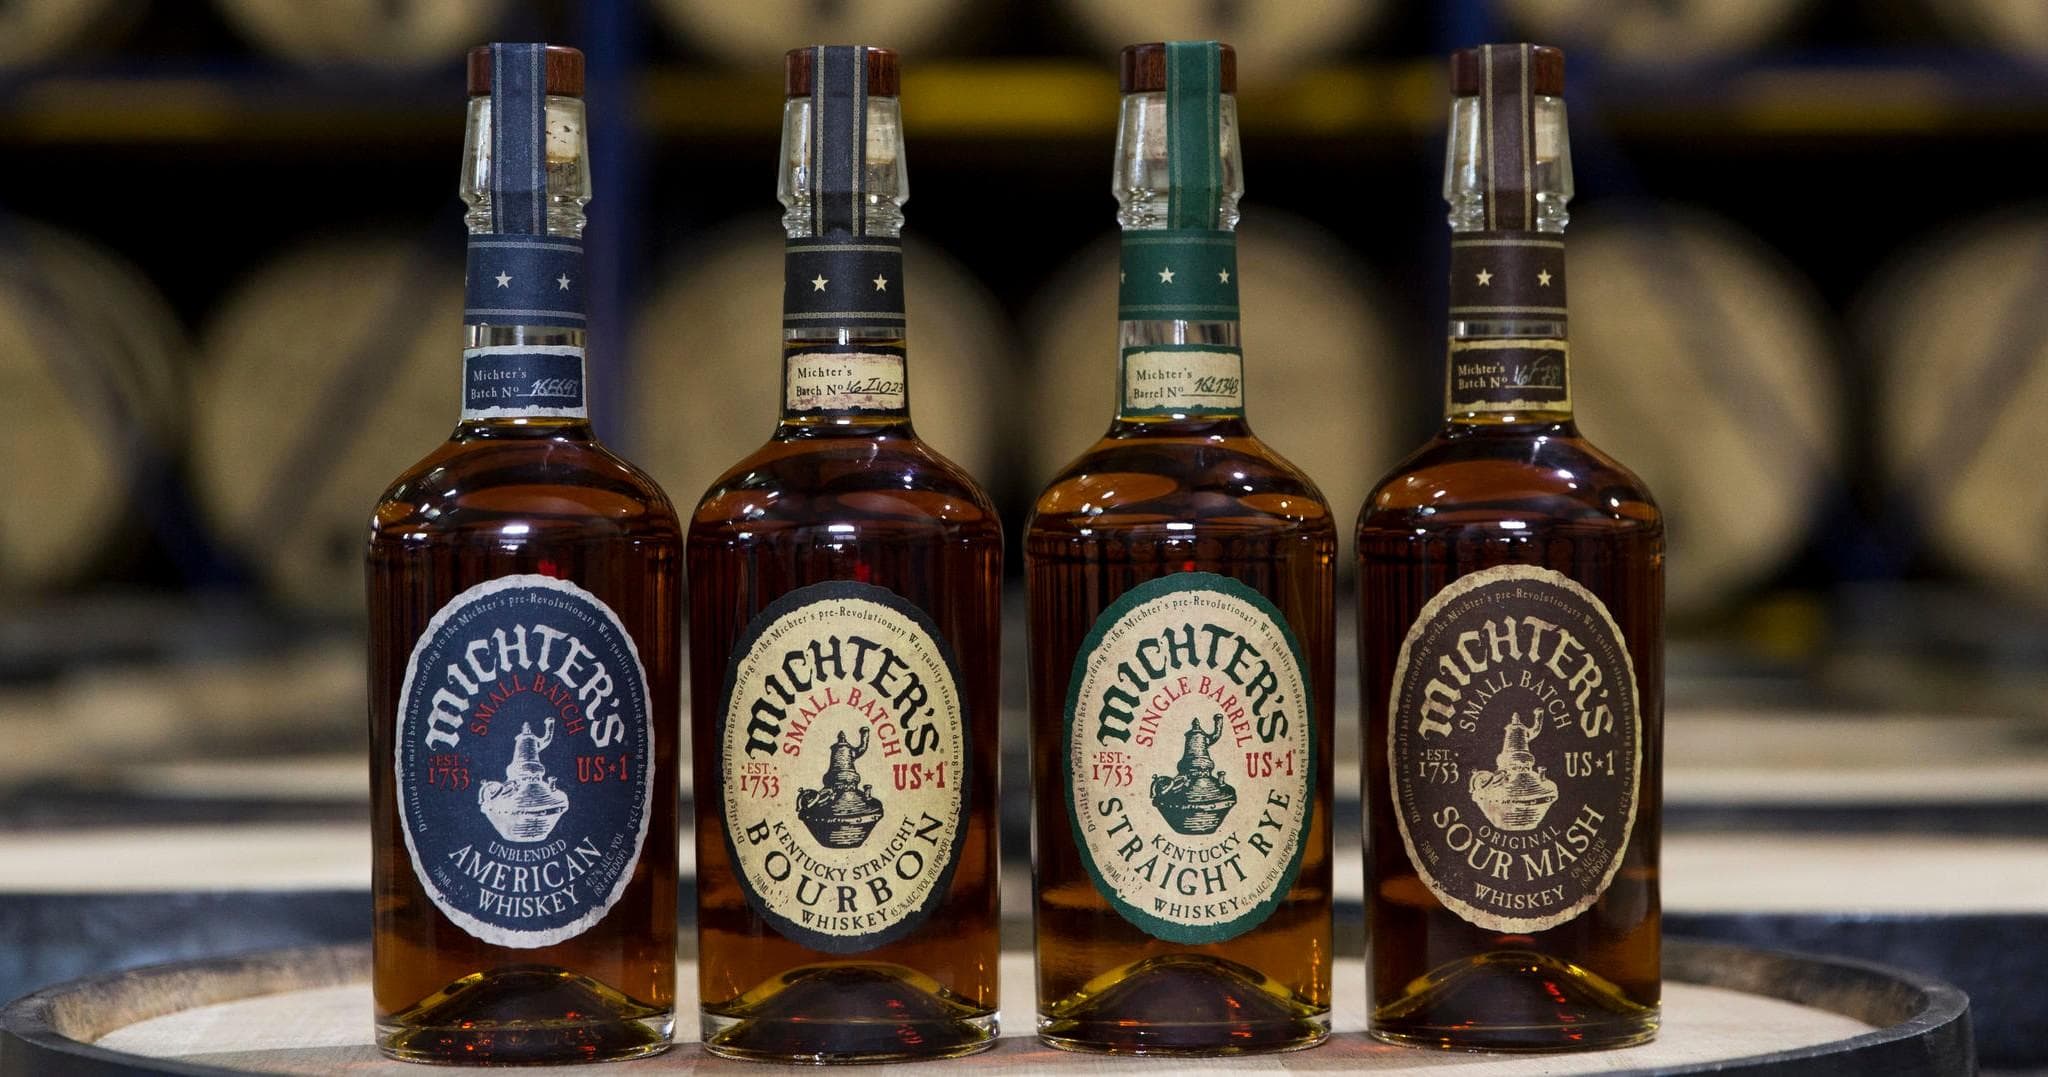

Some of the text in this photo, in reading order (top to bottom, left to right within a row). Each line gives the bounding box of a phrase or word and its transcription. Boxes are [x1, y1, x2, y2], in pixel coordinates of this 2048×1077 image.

[474, 367, 527, 381] Michter's
[798, 365, 852, 378] Michter's
[1136, 368, 1192, 381] Michter's
[1458, 362, 1505, 376] Michter's
[1458, 377, 1486, 390] Batch
[471, 387, 497, 400] Batch
[796, 385, 821, 397] Batch
[1134, 387, 1163, 399] Barrel
[1124, 601, 1169, 630] Michter's
[1173, 596, 1257, 627] pre-Revolutionary
[1448, 593, 1491, 622] Michter's
[1496, 588, 1581, 617] pre-Revolutionary
[771, 612, 814, 640] Michter's
[819, 606, 905, 639] pre-Revolutionary
[1111, 629, 1124, 642] the
[1260, 622, 1273, 640] War
[416, 651, 440, 695] according
[436, 640, 446, 649] to
[445, 624, 458, 638] the
[457, 597, 505, 627] Michter's
[509, 592, 596, 625] pre-Revolutionary
[599, 622, 611, 643] War
[758, 639, 771, 653] the
[909, 633, 922, 652] War
[1104, 644, 1111, 653] to
[1272, 641, 1291, 671] quality
[752, 653, 760, 663] to
[921, 652, 942, 683] quality
[425, 624, 625, 751] MICHTER'S
[733, 665, 755, 710] according
[1084, 655, 1106, 698] according
[1097, 623, 1289, 747] MICHTER'S
[1419, 616, 1614, 741] MICHTER'S
[470, 672, 585, 737] SMALL BATCH
[745, 635, 940, 759] MICHTER'S
[941, 685, 956, 731] standards
[1289, 674, 1304, 718] standards
[1460, 670, 1572, 733] SMALL BATCH
[783, 687, 902, 758] SMALL BATCH
[1076, 702, 1086, 738] batches
[1136, 676, 1253, 748] SINGLE BARREL
[726, 713, 736, 750] batches
[1299, 723, 1308, 754] dating
[428, 767, 471, 791] 1753
[725, 754, 733, 783] small
[1093, 765, 1133, 787] 1753
[1420, 762, 1459, 784] 1753
[727, 784, 733, 793] in
[741, 776, 779, 798] 1753
[951, 796, 958, 806] to
[728, 799, 744, 844] Distilled
[945, 812, 956, 835] 1753
[1078, 788, 1096, 832] Distilled
[488, 839, 567, 862] UNBLENDED
[773, 816, 915, 882] KENTUCKY STRAIGHT
[1098, 789, 1290, 896] STRAIGHT RYE
[1151, 832, 1242, 863] KENTUCKY
[1433, 804, 1605, 881] SOUR MASH
[1479, 825, 1561, 848] ORIGINAL
[448, 836, 602, 893] AMERICAN
[746, 812, 943, 913] BOURBON
[479, 884, 579, 918] WHISKEY
[1154, 897, 1241, 918] WHISKEY
[1474, 882, 1566, 909] WHISKEY
[802, 908, 889, 930] WHISKEY
